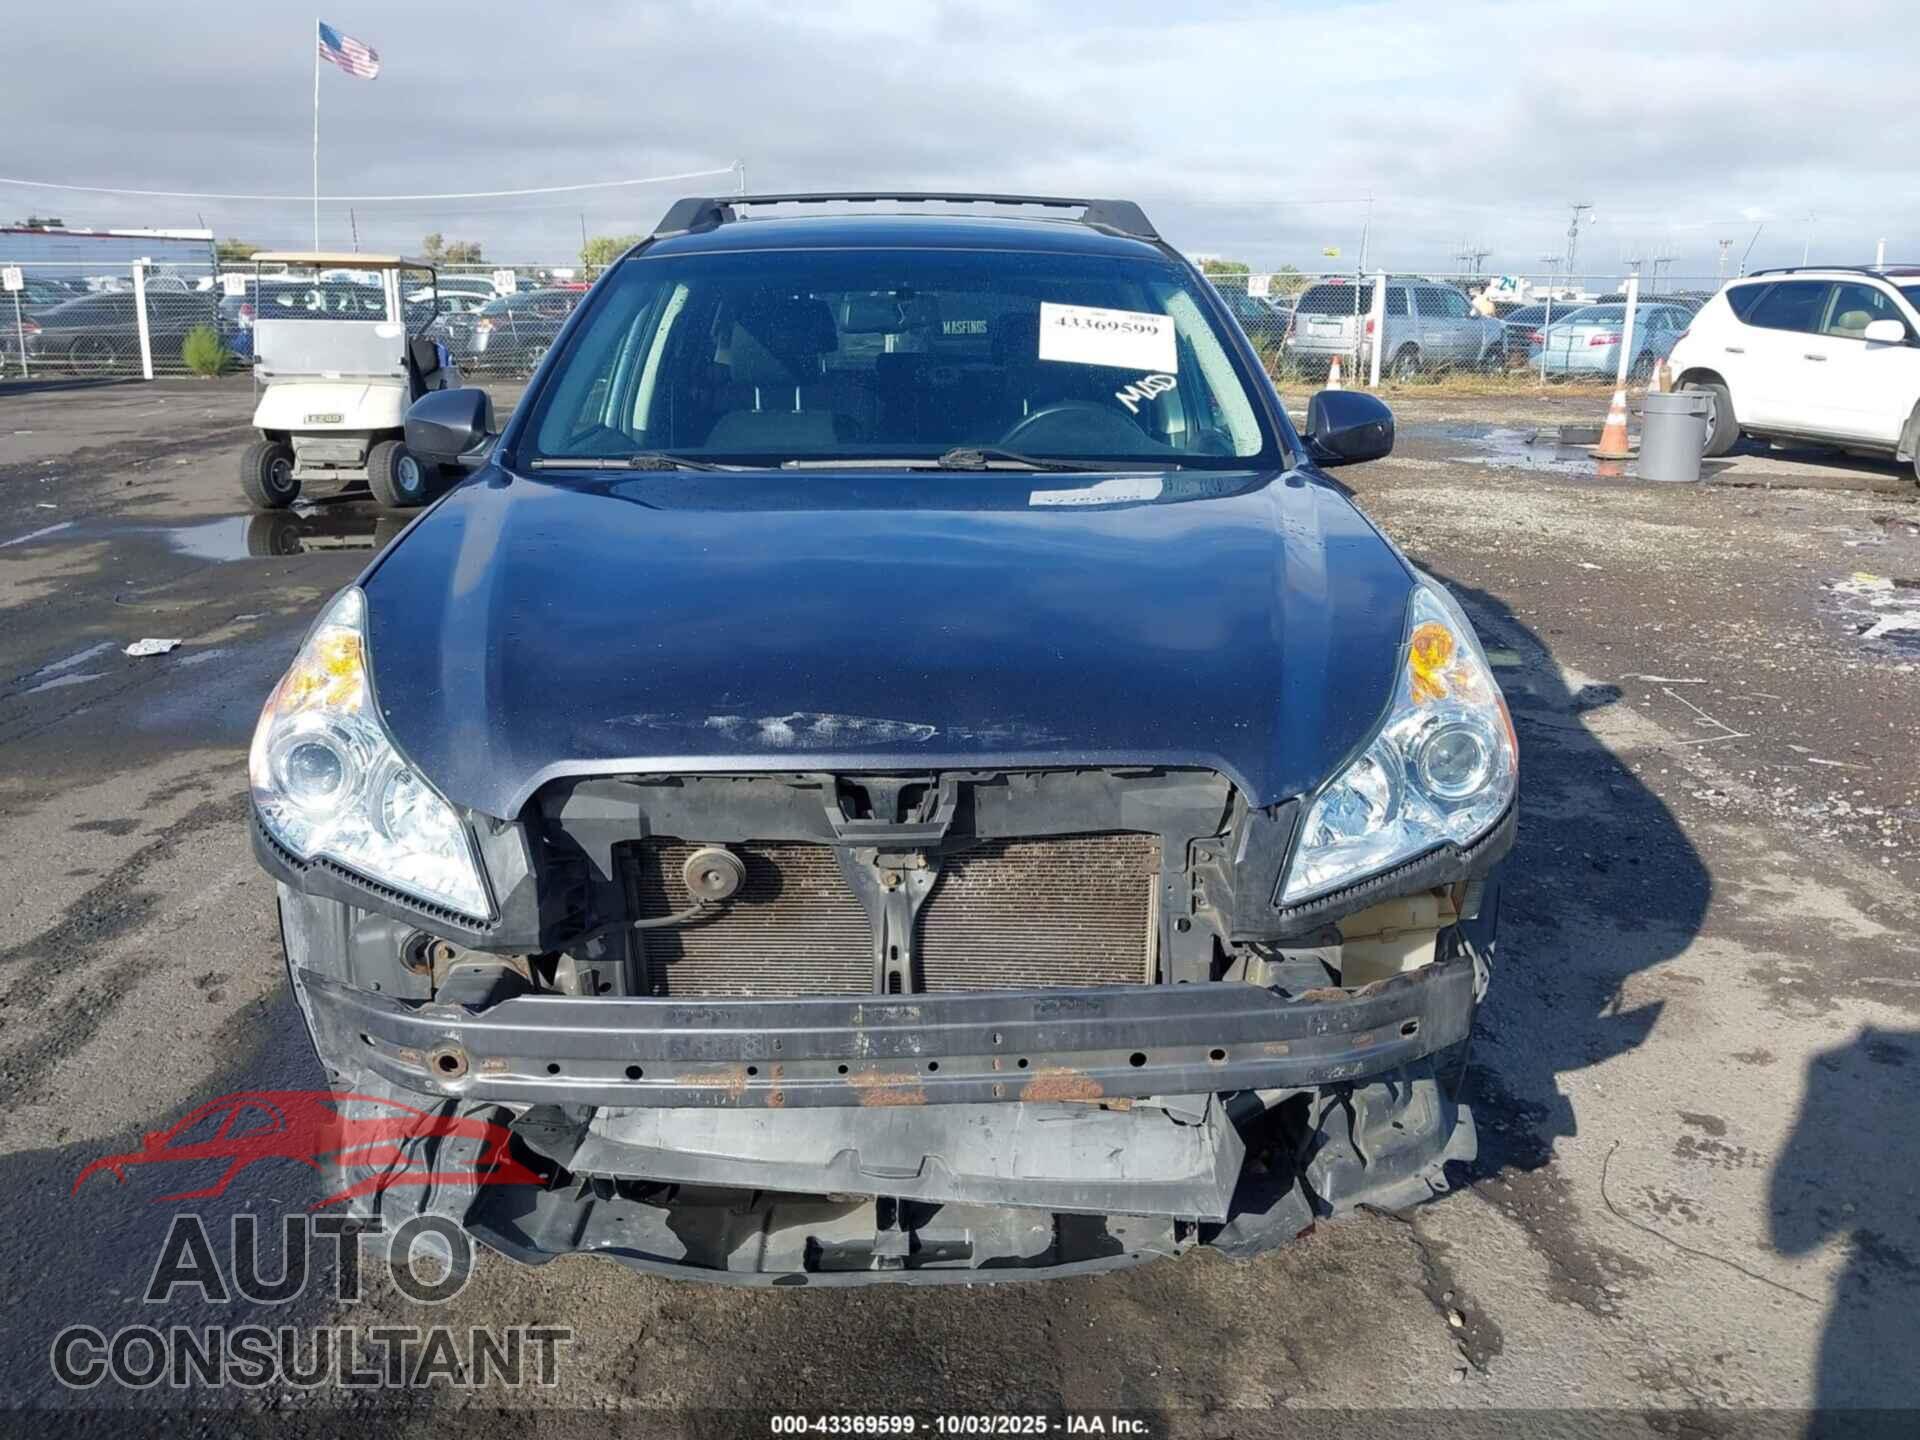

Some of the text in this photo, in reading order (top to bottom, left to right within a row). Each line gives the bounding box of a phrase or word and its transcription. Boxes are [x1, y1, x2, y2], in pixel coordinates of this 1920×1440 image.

[496, 272, 513, 286] 20
[1499, 275, 1517, 292] 24
[1053, 315, 1160, 336] 43369599
